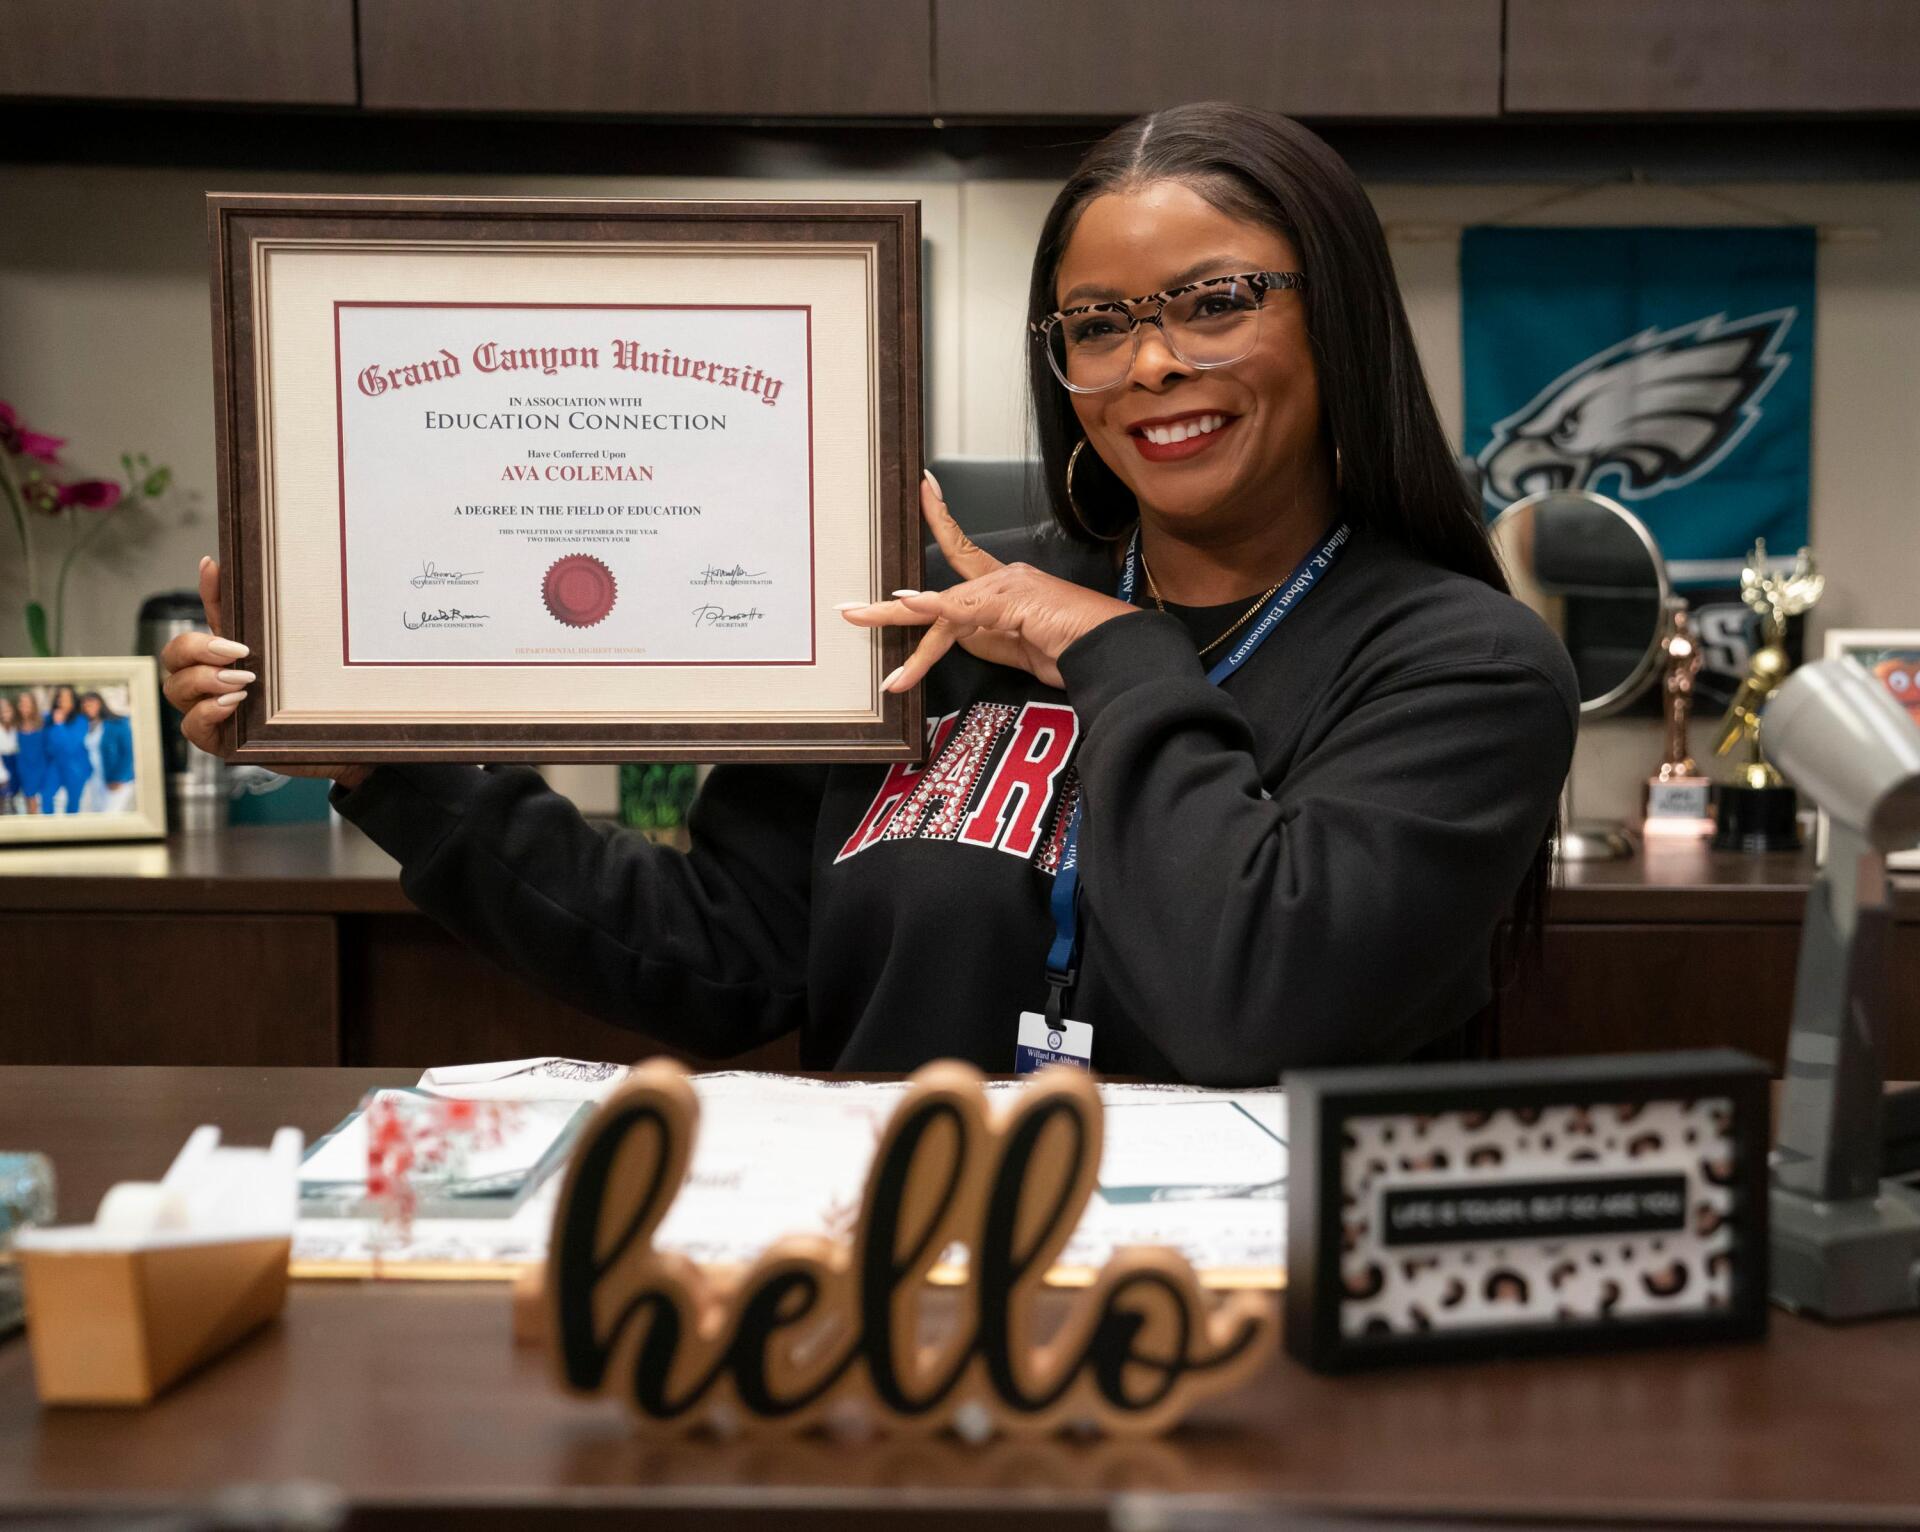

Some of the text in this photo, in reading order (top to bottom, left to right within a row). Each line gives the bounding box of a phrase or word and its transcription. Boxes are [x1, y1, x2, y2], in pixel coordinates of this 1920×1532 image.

[357, 338, 785, 407] Grand Canyon University
[509, 397, 642, 407] IN ASSOCIATION WITH
[425, 410, 727, 431] EDUCATION CONNECTION
[527, 449, 627, 461] Have Conferred Upon
[501, 465, 653, 482] AVA COLEMAN
[454, 505, 701, 516] A DEGREE IN THE FIELD OF EDUCATION
[1229, 523, 1352, 666] Willard R. Abbott Elementary
[1027, 1048, 1050, 1060] Willard
[554, 1094, 1264, 1422] hello
